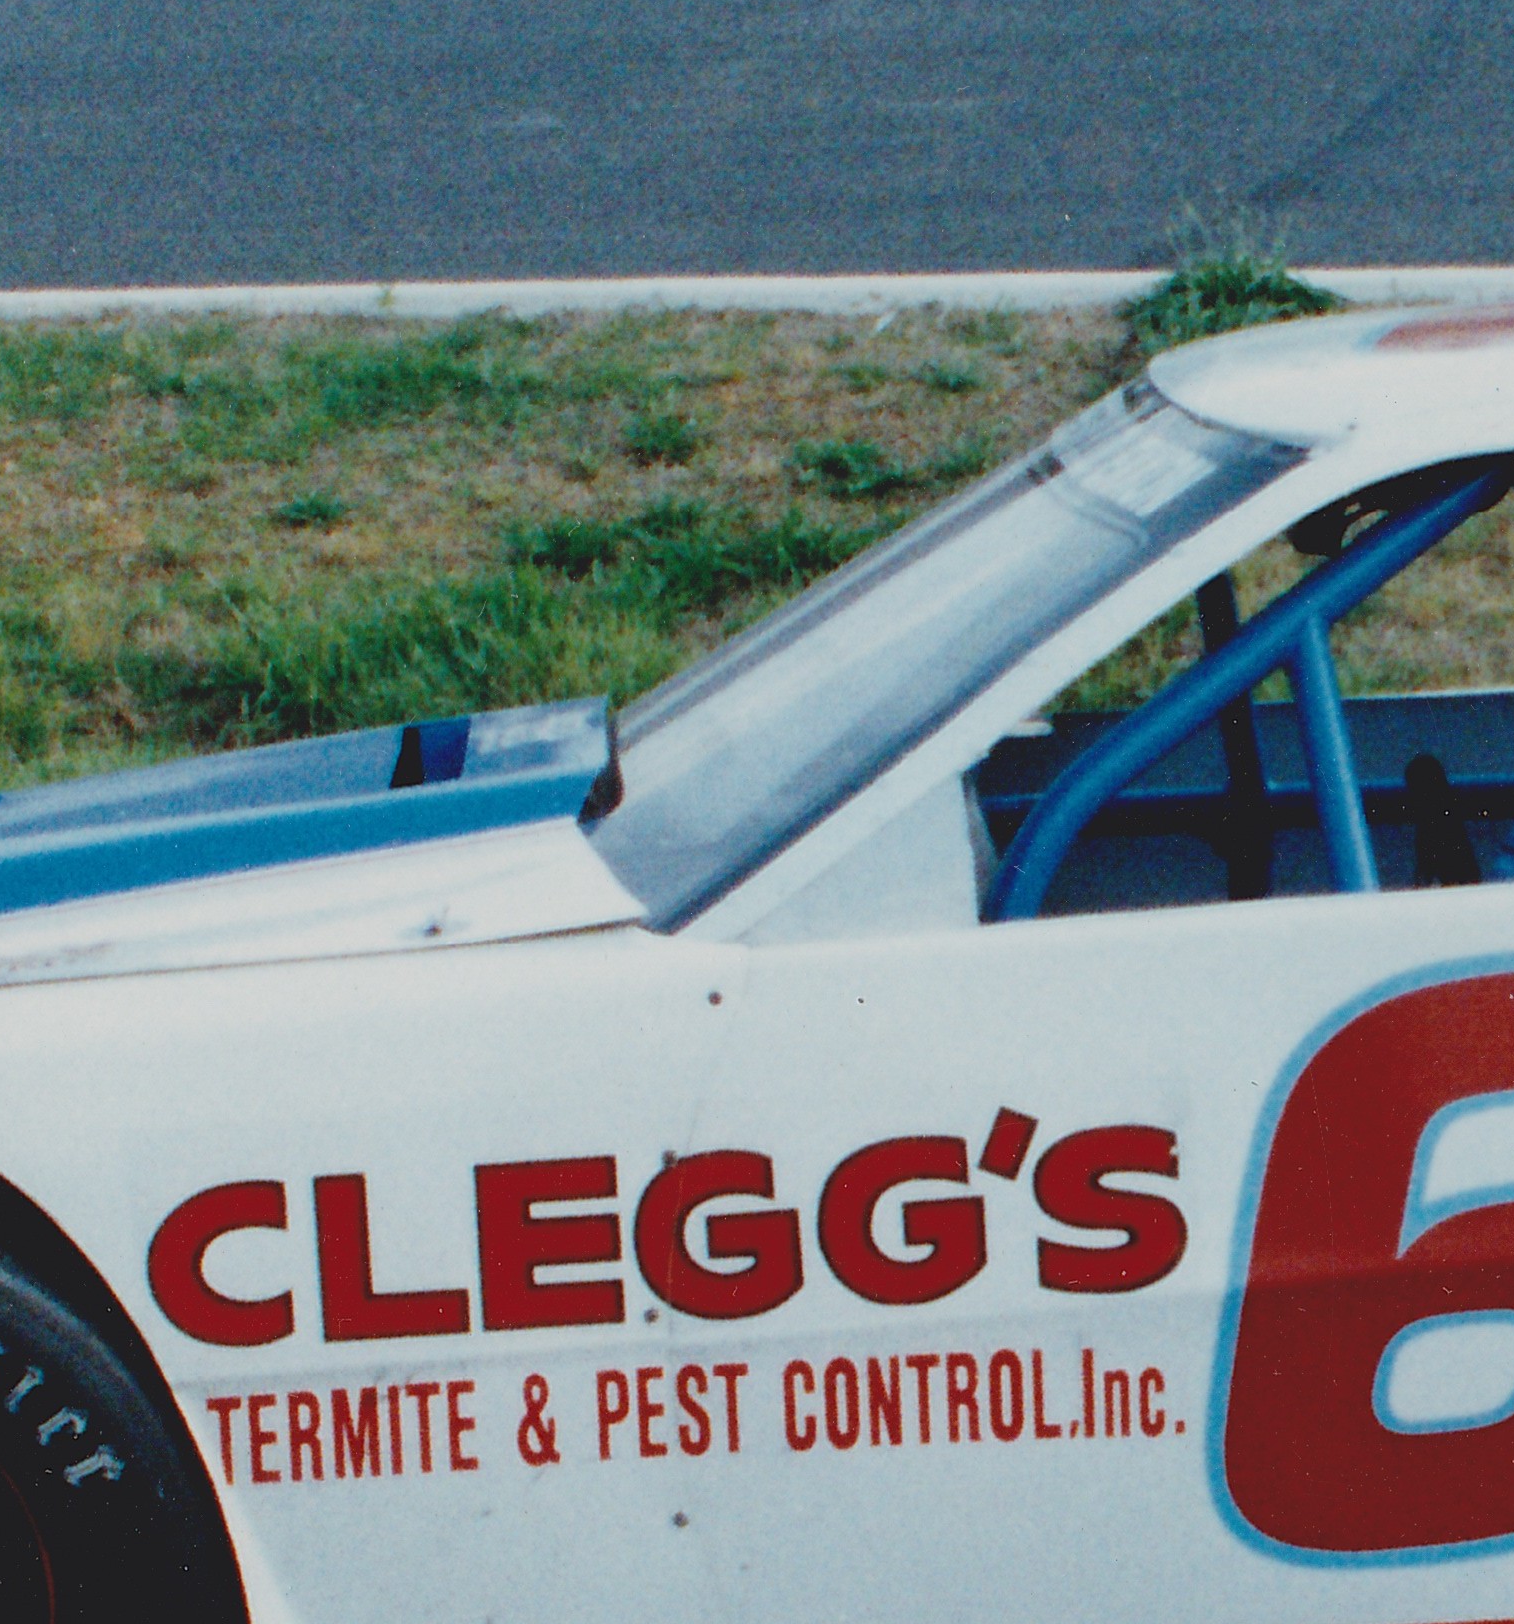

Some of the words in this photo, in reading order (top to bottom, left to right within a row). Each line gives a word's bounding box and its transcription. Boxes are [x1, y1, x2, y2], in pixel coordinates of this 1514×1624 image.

[148, 1107, 1188, 1347] CLEGG'S
[207, 1379, 480, 1487] TERMITE
[517, 1372, 562, 1467] &
[595, 1362, 750, 1461] PEST
